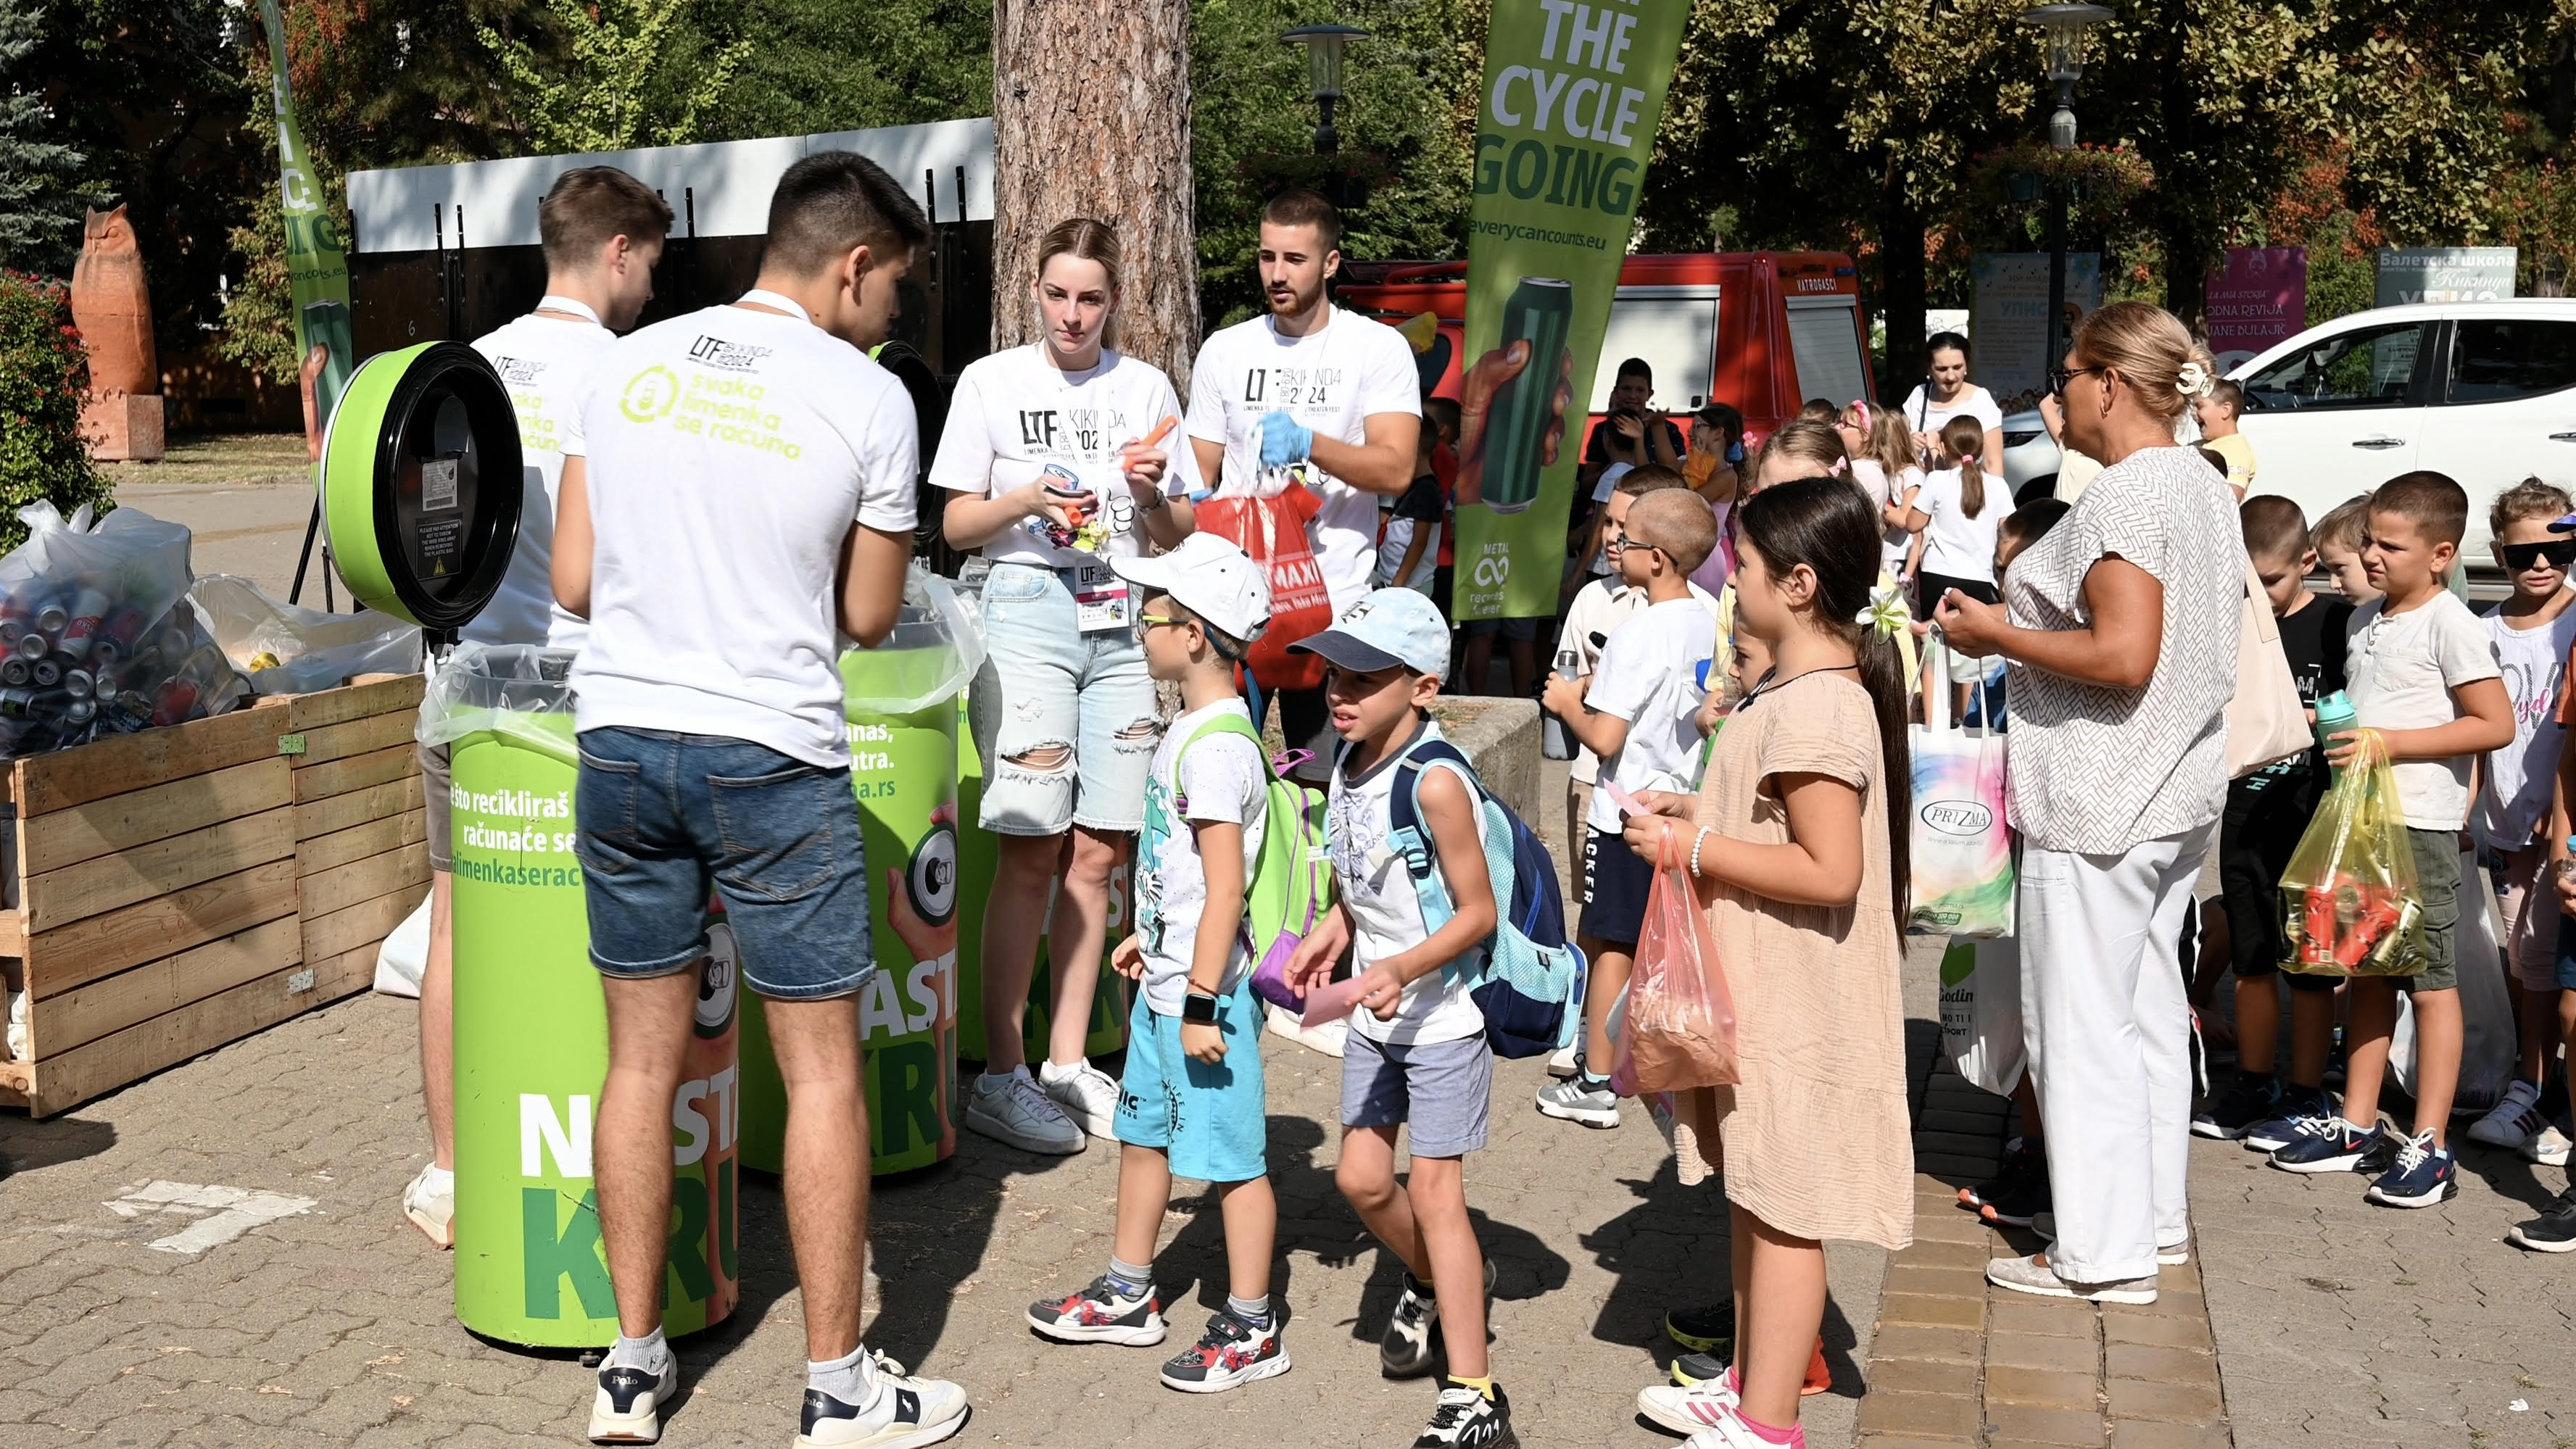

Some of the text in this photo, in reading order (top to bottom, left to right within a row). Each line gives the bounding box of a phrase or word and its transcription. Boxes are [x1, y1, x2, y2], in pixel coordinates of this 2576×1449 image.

[1540, 0, 1638, 75] THE
[1491, 65, 1646, 148] CYCLE
[1473, 133, 1639, 216] GOING
[1468, 220, 1607, 251] everycancounts.eu
[2380, 254, 2516, 267] Балетска школа
[1797, 278, 1837, 291] VATROGASCI
[408, 320, 416, 336] 6
[688, 334, 726, 361] LTF
[691, 373, 766, 401] svaka
[681, 390, 782, 431] limenka
[674, 415, 703, 435] se
[1019, 410, 1058, 449] LTF
[1080, 566, 1096, 583] LTF
[455, 782, 471, 811] što
[473, 789, 570, 818] recikliraš
[1931, 806, 1987, 827] PRIZMA
[463, 821, 576, 852] računaće se
[610, 1374, 638, 1385] Polo
